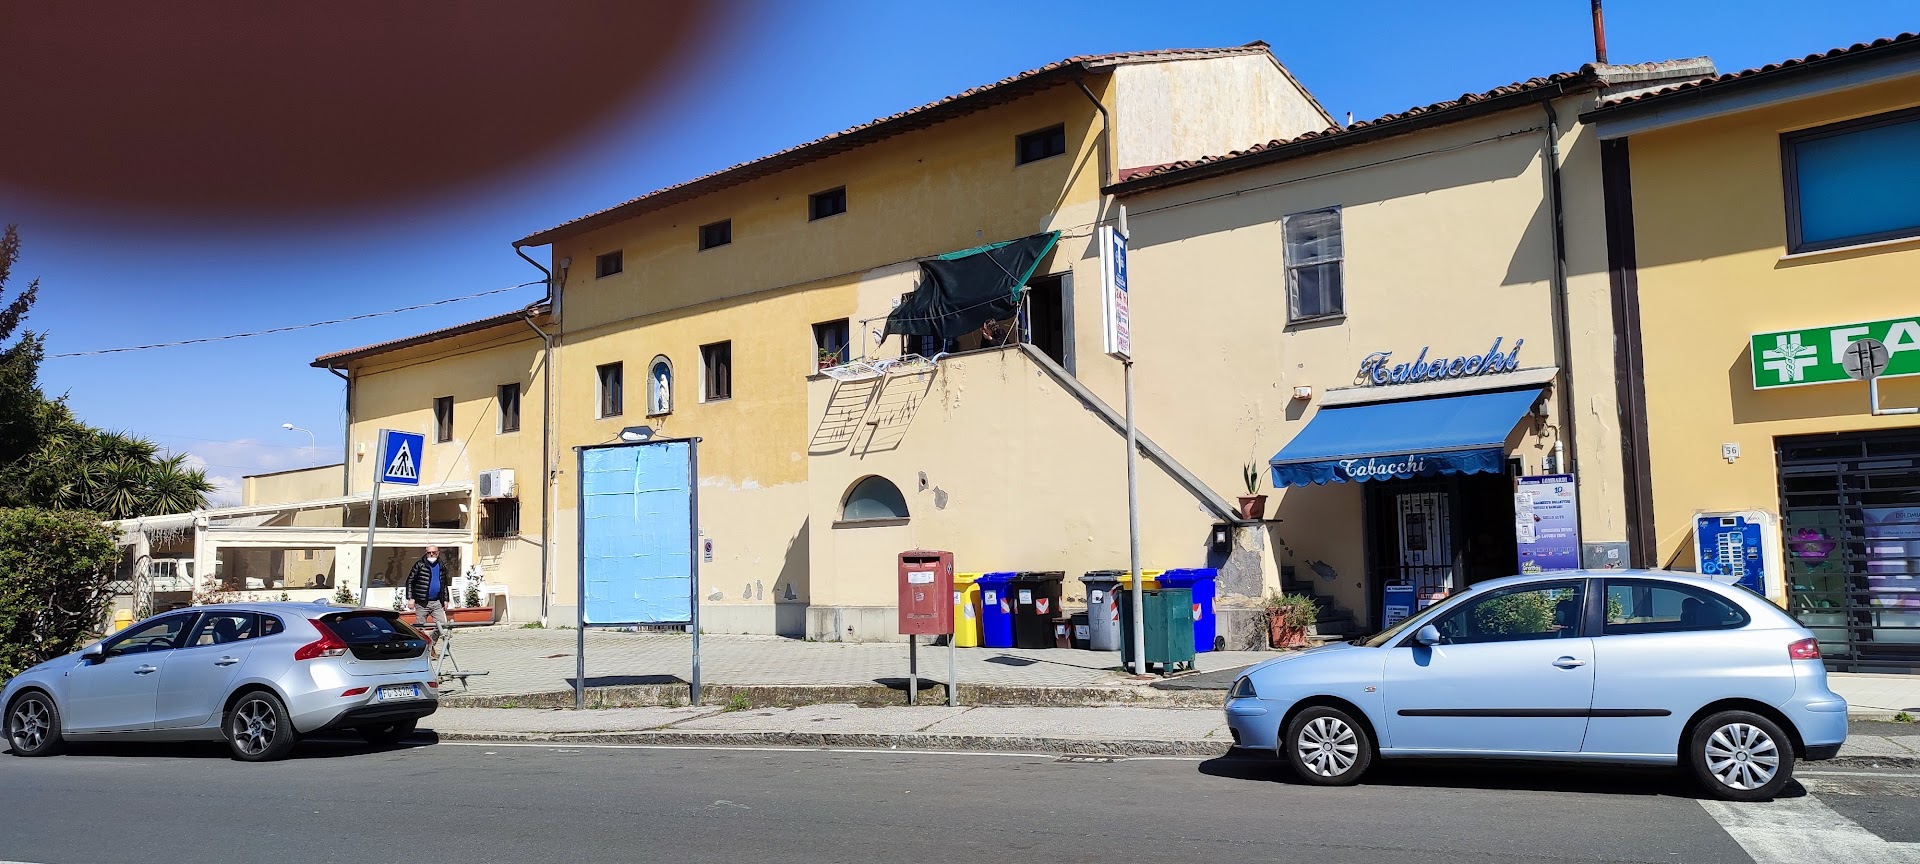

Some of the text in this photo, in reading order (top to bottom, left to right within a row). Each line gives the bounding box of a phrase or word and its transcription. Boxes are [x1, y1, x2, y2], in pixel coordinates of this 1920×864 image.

[1360, 336, 1524, 385] Tabacchi
[1725, 446, 1737, 455] 56
[1339, 454, 1426, 478] Tabacchi
